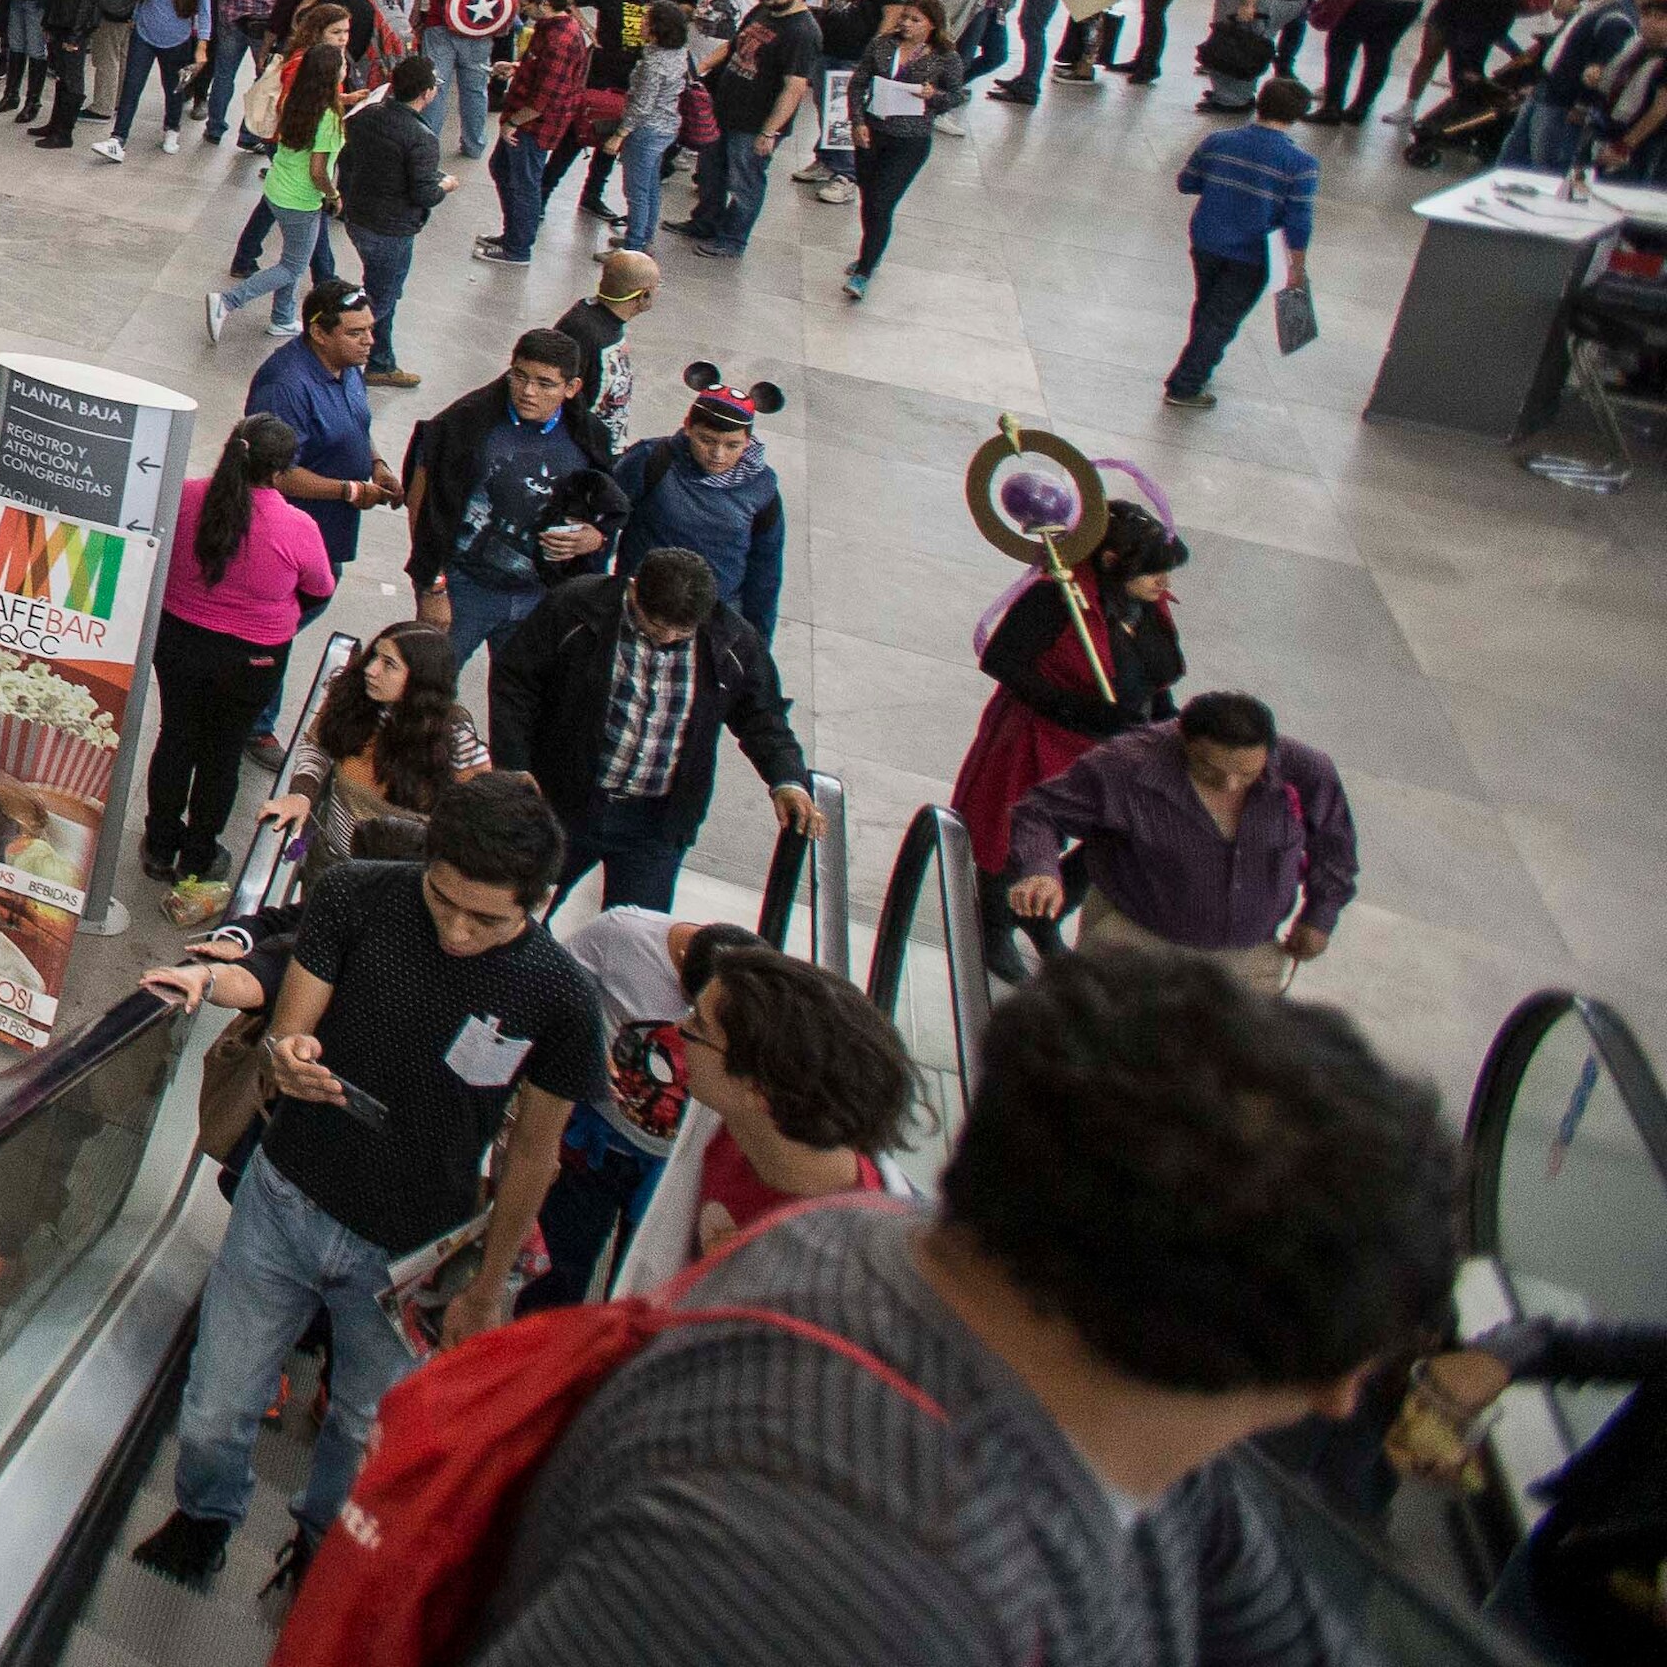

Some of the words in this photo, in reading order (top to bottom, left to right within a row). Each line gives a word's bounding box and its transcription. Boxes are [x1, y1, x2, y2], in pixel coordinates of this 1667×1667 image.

[12, 379, 73, 413] PLANTA
[78, 400, 123, 424] BAJA
[4, 439, 79, 474] ATENCIÓN
[82, 465, 94, 478] A
[6, 422, 73, 456] REGISTRO
[78, 445, 89, 459] Y
[2, 453, 113, 498] CONGRESISTAS
[28, 880, 79, 907] BEBIDAS
[9, 1019, 36, 1041] PISO
